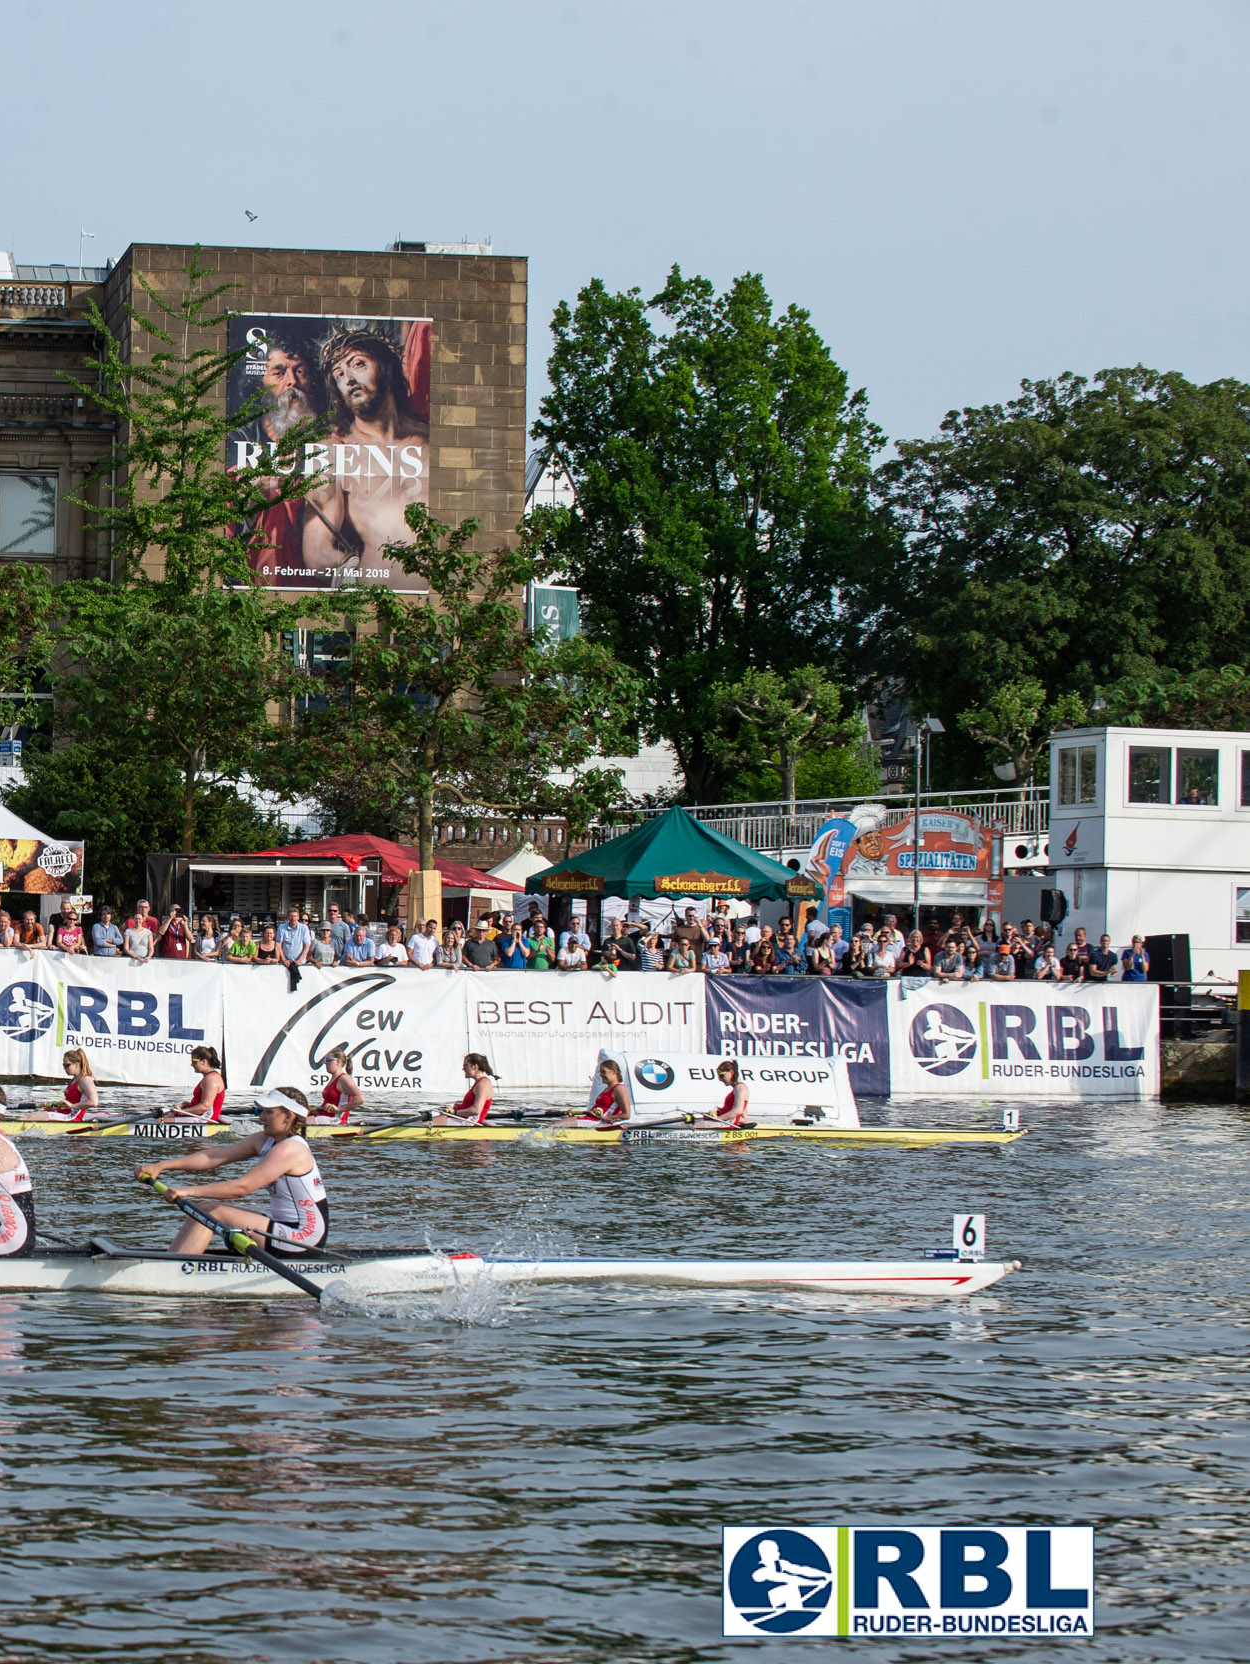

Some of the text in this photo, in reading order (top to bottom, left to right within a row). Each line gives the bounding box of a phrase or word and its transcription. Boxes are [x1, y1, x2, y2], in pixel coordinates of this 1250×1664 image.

[234, 440, 423, 478] RUBENS
[344, 568, 362, 578] Mai
[365, 569, 390, 579] 2018
[831, 840, 846, 849] SOFT
[829, 847, 845, 858] EIS
[39, 854, 76, 866] FALAFEL
[898, 851, 977, 870] SPEZIALITÄTEN
[67, 986, 205, 1041] RBL
[477, 1001, 695, 1025] BEST AUDIT
[719, 1011, 810, 1035] RUDER-
[990, 1004, 1145, 1061] RBL
[65, 1034, 194, 1055] RUDER-BUNDESLIG
[688, 1067, 830, 1084] EUR GROUP
[992, 1064, 1146, 1078] RUDER-BUNDESLIGA
[310, 1074, 422, 1089] SPTSWEAR
[1006, 1111, 1013, 1125] 1
[134, 1124, 204, 1138] MINDEN
[633, 1131, 653, 1139] RBL
[732, 1131, 743, 1139] BS
[744, 1131, 759, 1139] 001
[962, 1216, 977, 1247] 6
[197, 1262, 228, 1272] RBL
